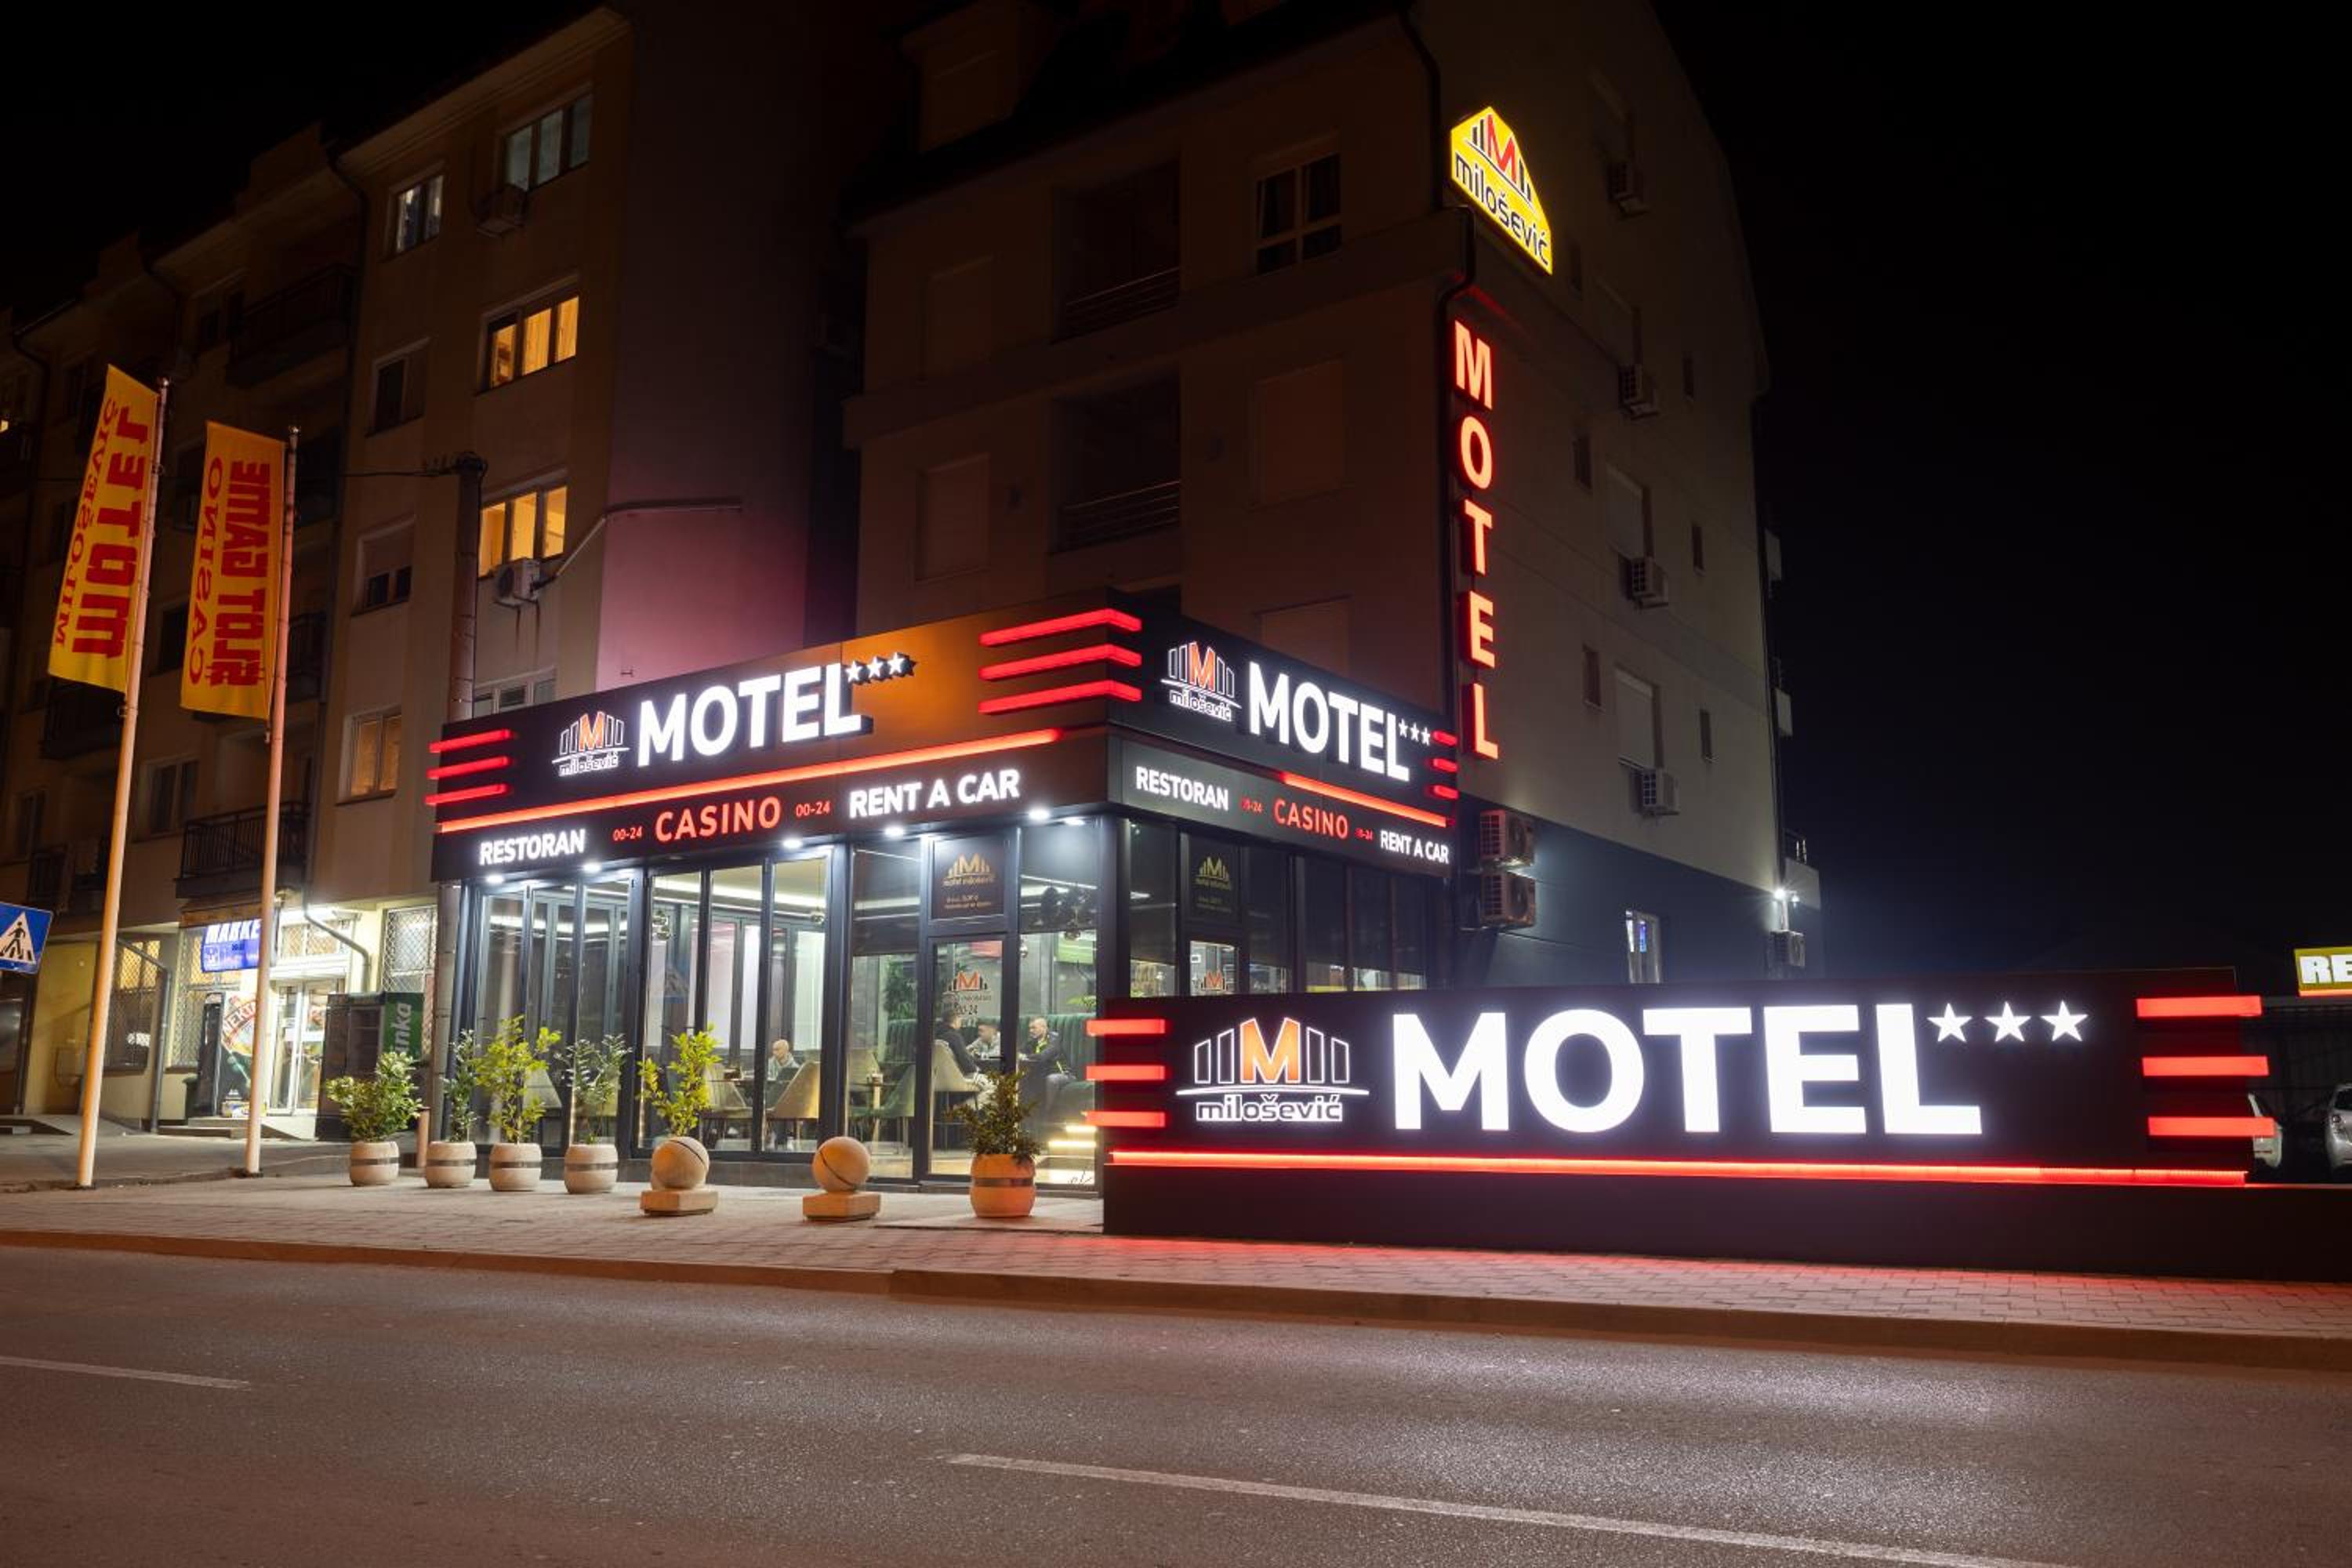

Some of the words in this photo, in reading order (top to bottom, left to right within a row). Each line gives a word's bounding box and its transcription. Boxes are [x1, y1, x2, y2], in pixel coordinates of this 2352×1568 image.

[1454, 151, 1549, 267] milošević
[1454, 319, 1499, 760] MOTEL
[637, 662, 866, 768] MOTEL
[1249, 661, 1410, 782] MOTEL
[478, 828, 586, 866] RESTORAN
[612, 825, 643, 841] 00-24
[655, 796, 782, 843] CASINO
[795, 800, 832, 818] 00-24
[848, 780, 922, 819] RENT
[928, 779, 951, 808] A
[956, 769, 1021, 802] CAR
[1135, 765, 1229, 812] RESTORAN
[1273, 797, 1349, 840] CASINO
[1380, 829, 1411, 855] RENT
[1413, 839, 1424, 858] A
[1425, 843, 1450, 864] CAR
[205, 919, 263, 944] MARKE
[2299, 954, 2352, 984] RE
[1196, 1093, 1344, 1123] milošević
[1392, 1003, 1983, 1135] MOTEL
